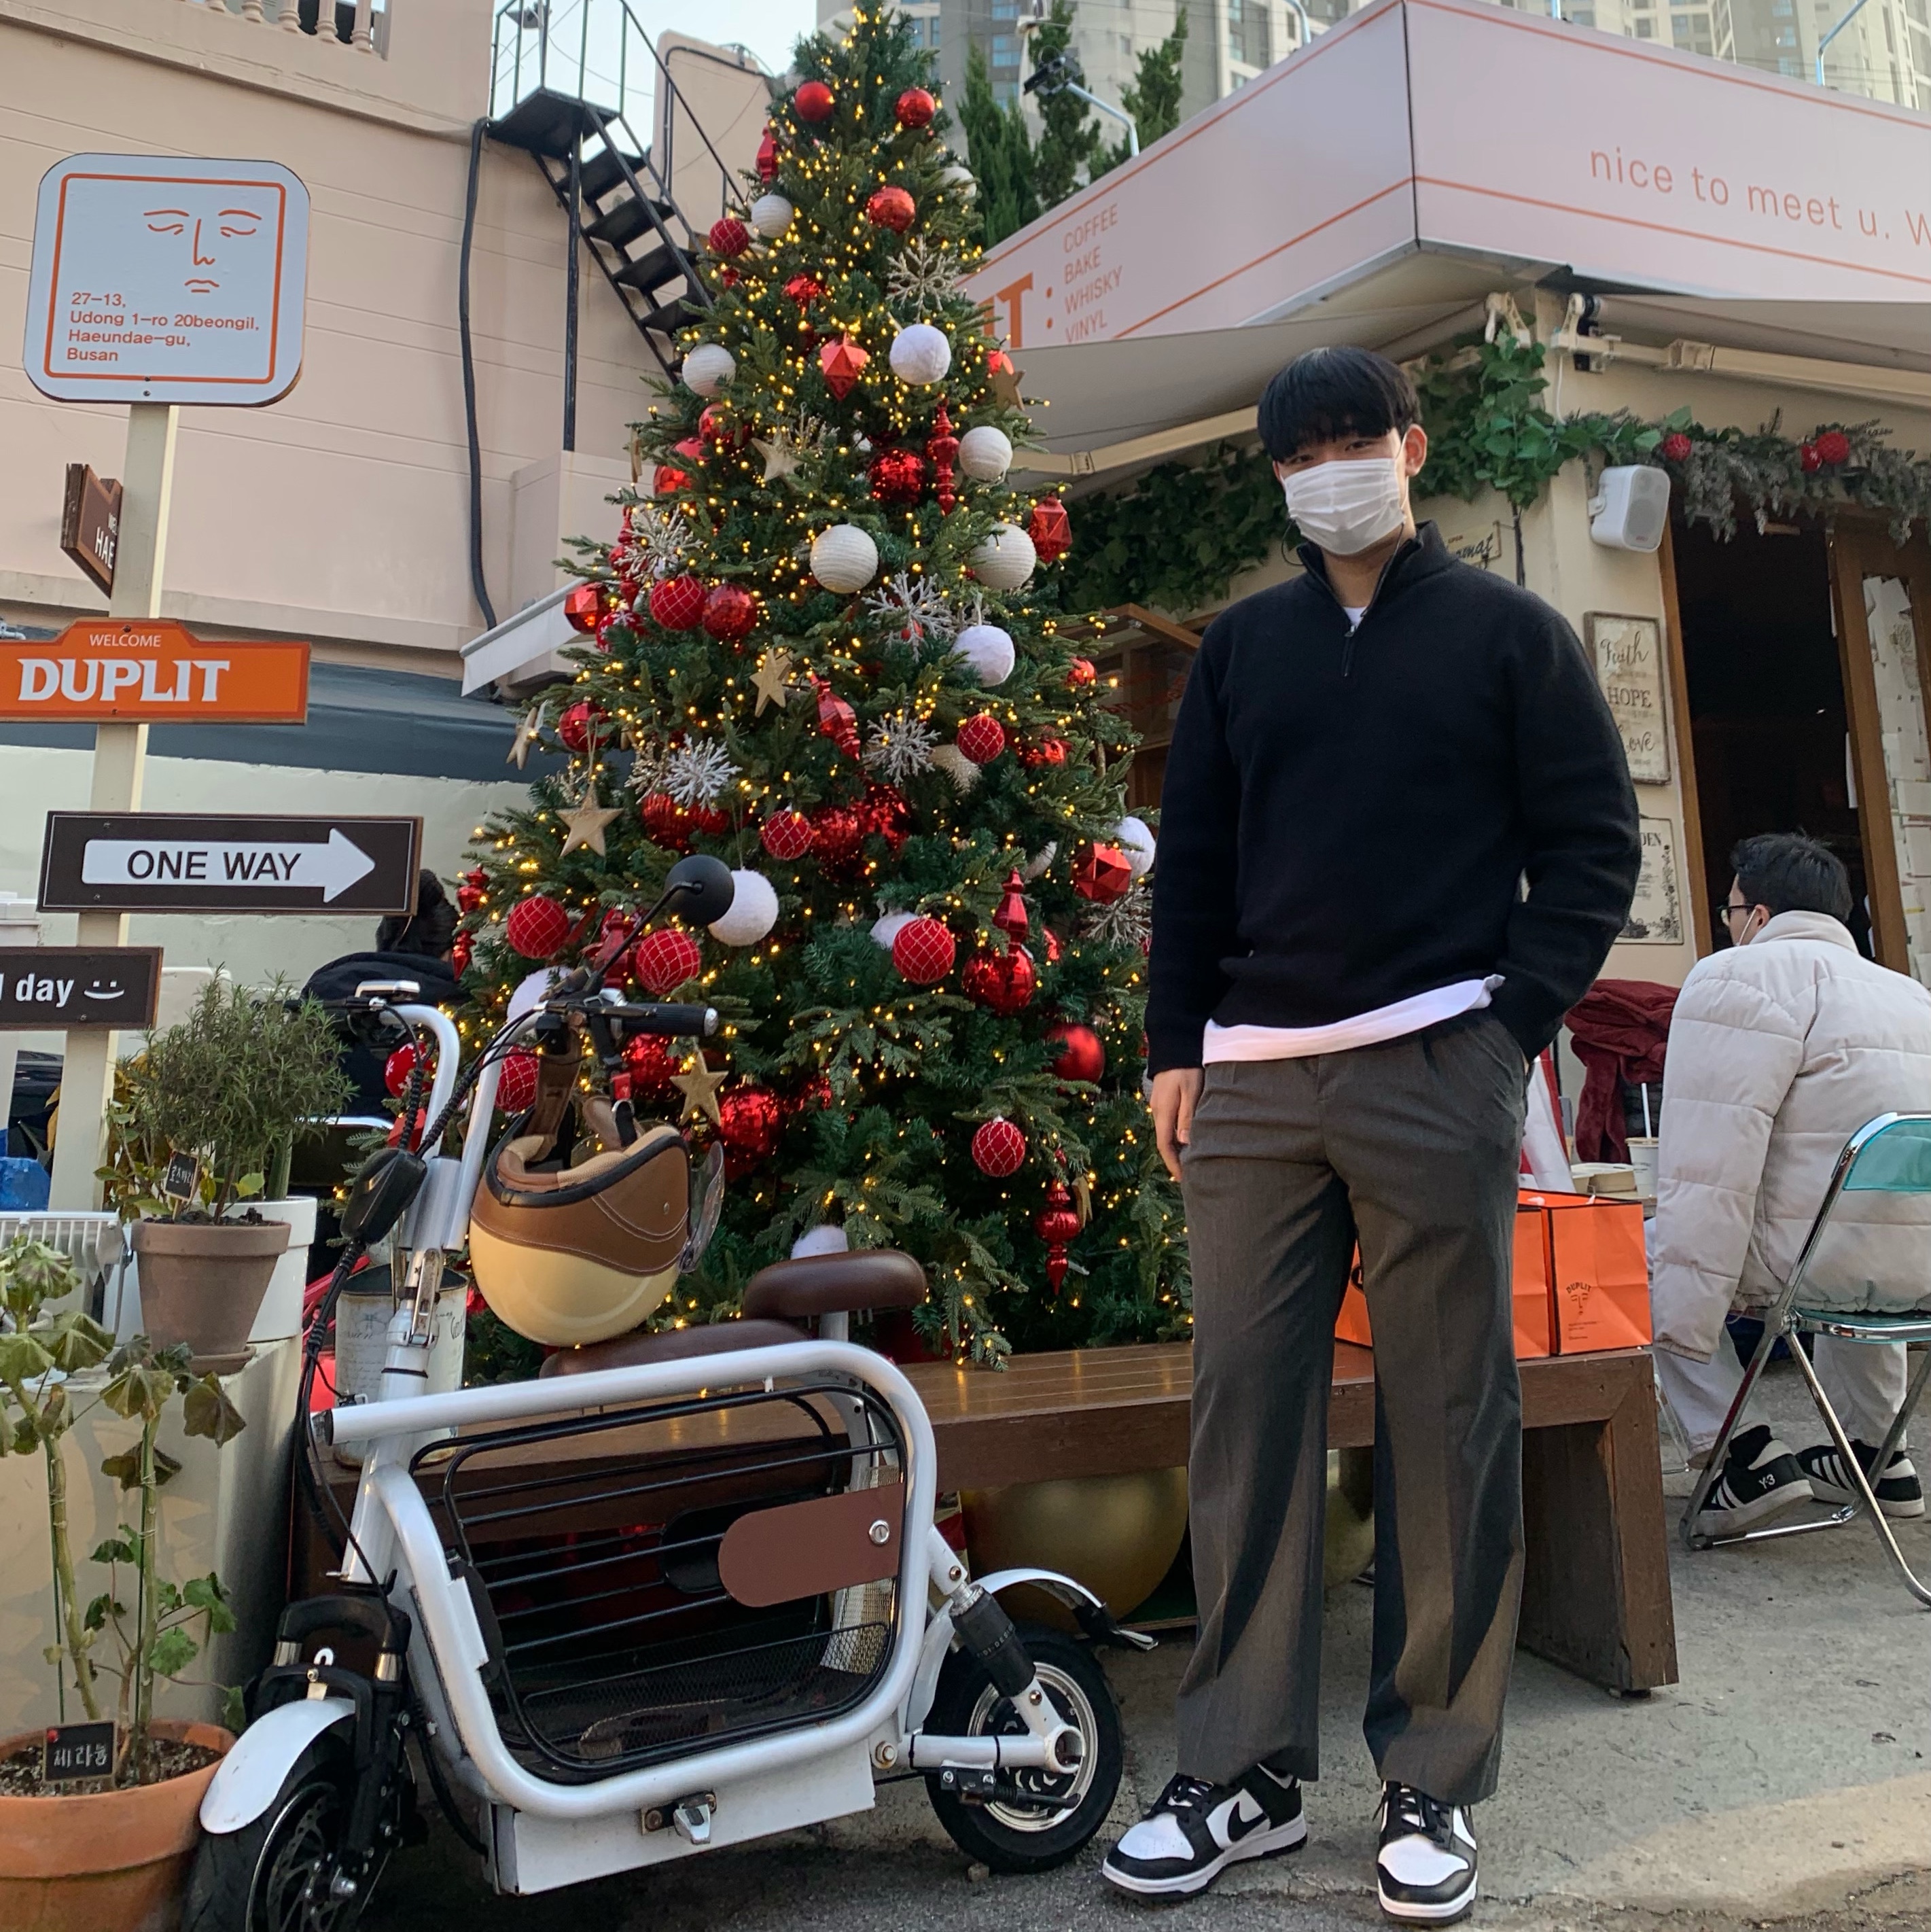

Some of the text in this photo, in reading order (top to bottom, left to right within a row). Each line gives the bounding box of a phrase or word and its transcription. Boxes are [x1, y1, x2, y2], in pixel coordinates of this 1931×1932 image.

[1591, 146, 1673, 193] nice
[1692, 167, 1729, 206] to
[1748, 185, 1843, 230] meet
[1859, 209, 1890, 239] u.
[1064, 203, 1118, 253] COFFEE
[1065, 245, 1101, 284] BAKE
[71, 292, 126, 308] 27-13,
[1065, 265, 1122, 314] WHISKY
[70, 311, 260, 331] Udong 1-ro 20beongil,
[1065, 309, 1108, 343] VINYL
[69, 329, 191, 347] Haeundae-gu,
[67, 348, 118, 362] Busan
[89, 634, 162, 648] WELCOME
[1600, 630, 1650, 668] Faith
[17, 658, 230, 701] DUPLIT
[1607, 686, 1652, 708] HOPE
[127, 849, 302, 881] ONE WAY
[15, 972, 75, 1008] day
[1566, 1282, 1591, 1294] DUPLIT
